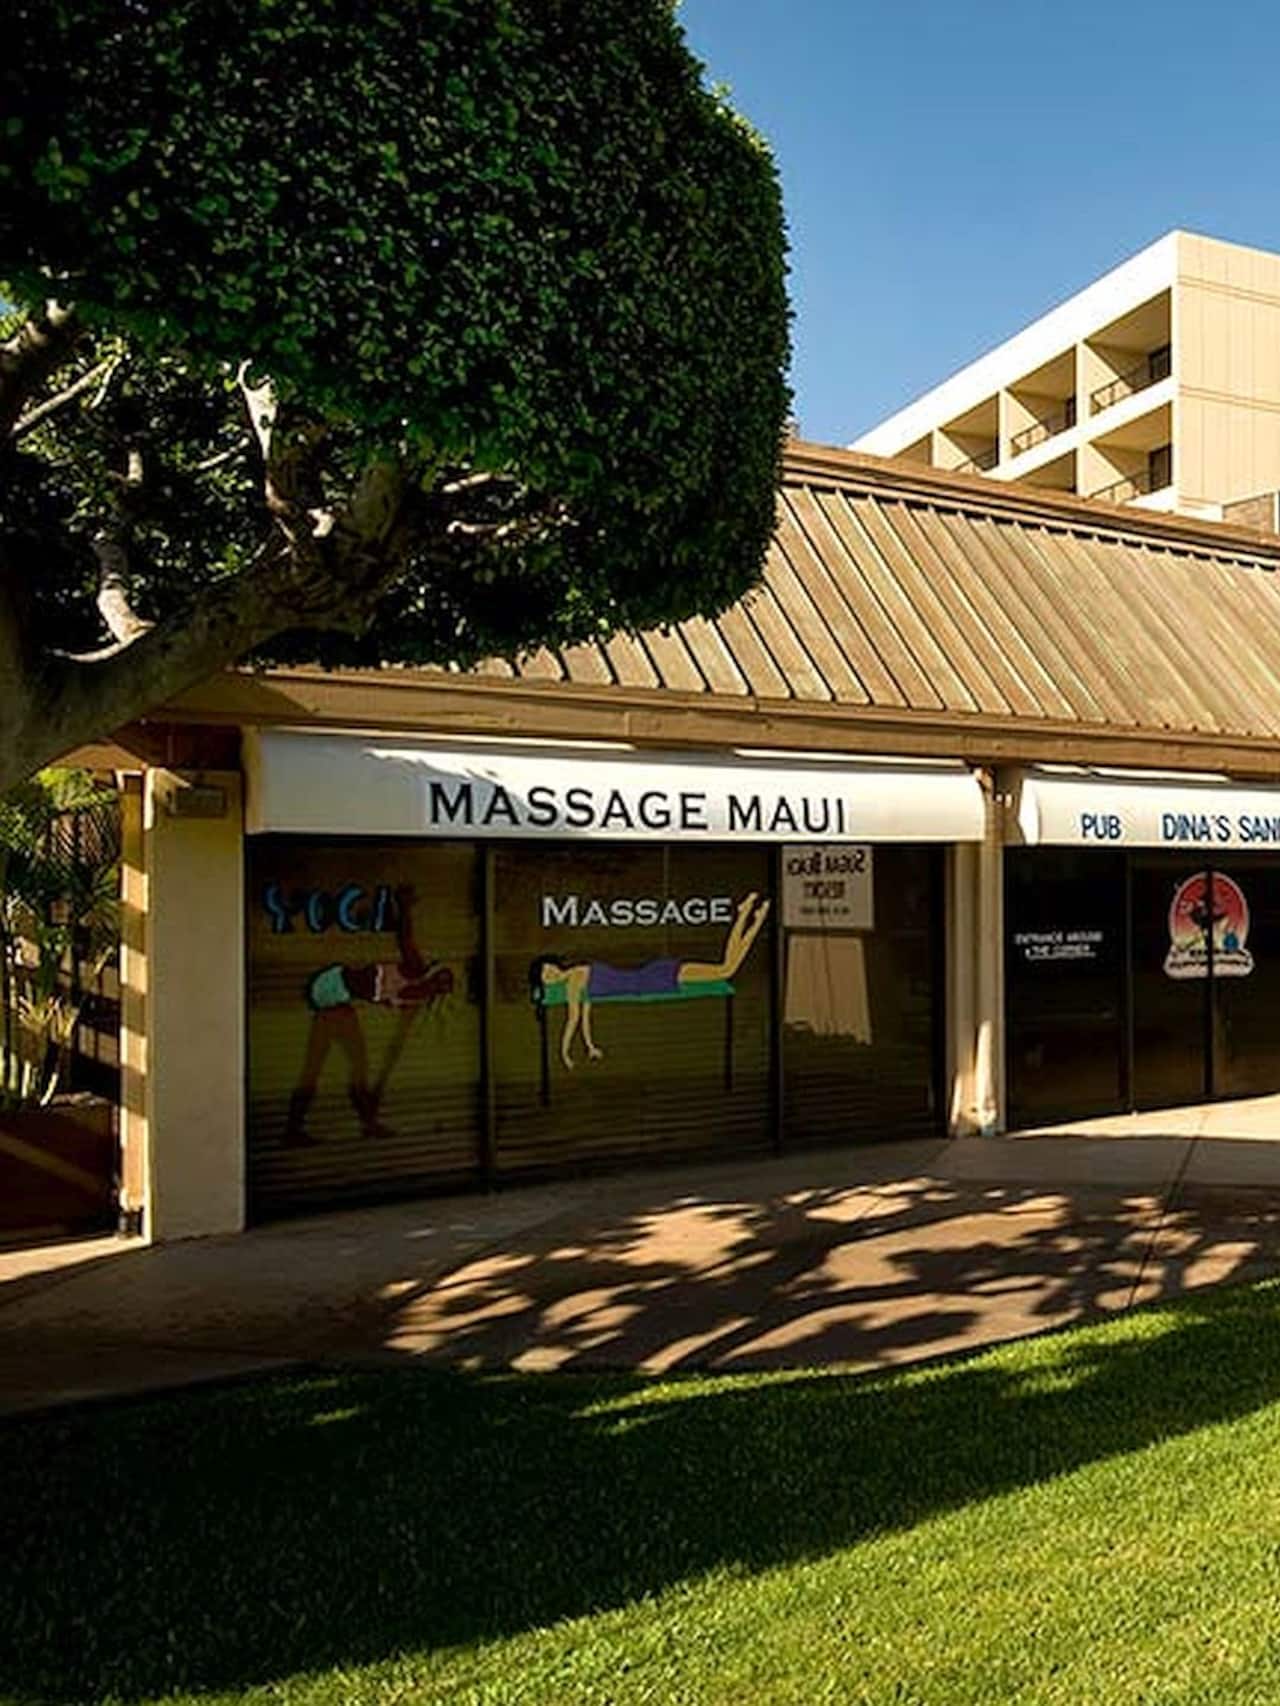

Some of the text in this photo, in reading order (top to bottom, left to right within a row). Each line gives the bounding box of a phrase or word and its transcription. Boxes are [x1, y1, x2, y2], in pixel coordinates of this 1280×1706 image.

[430, 782, 844, 833] MASSAGE MAUI
[1081, 813, 1121, 840] PUB
[1162, 813, 1231, 842] DINA'S
[542, 896, 733, 927] MASSAGE
